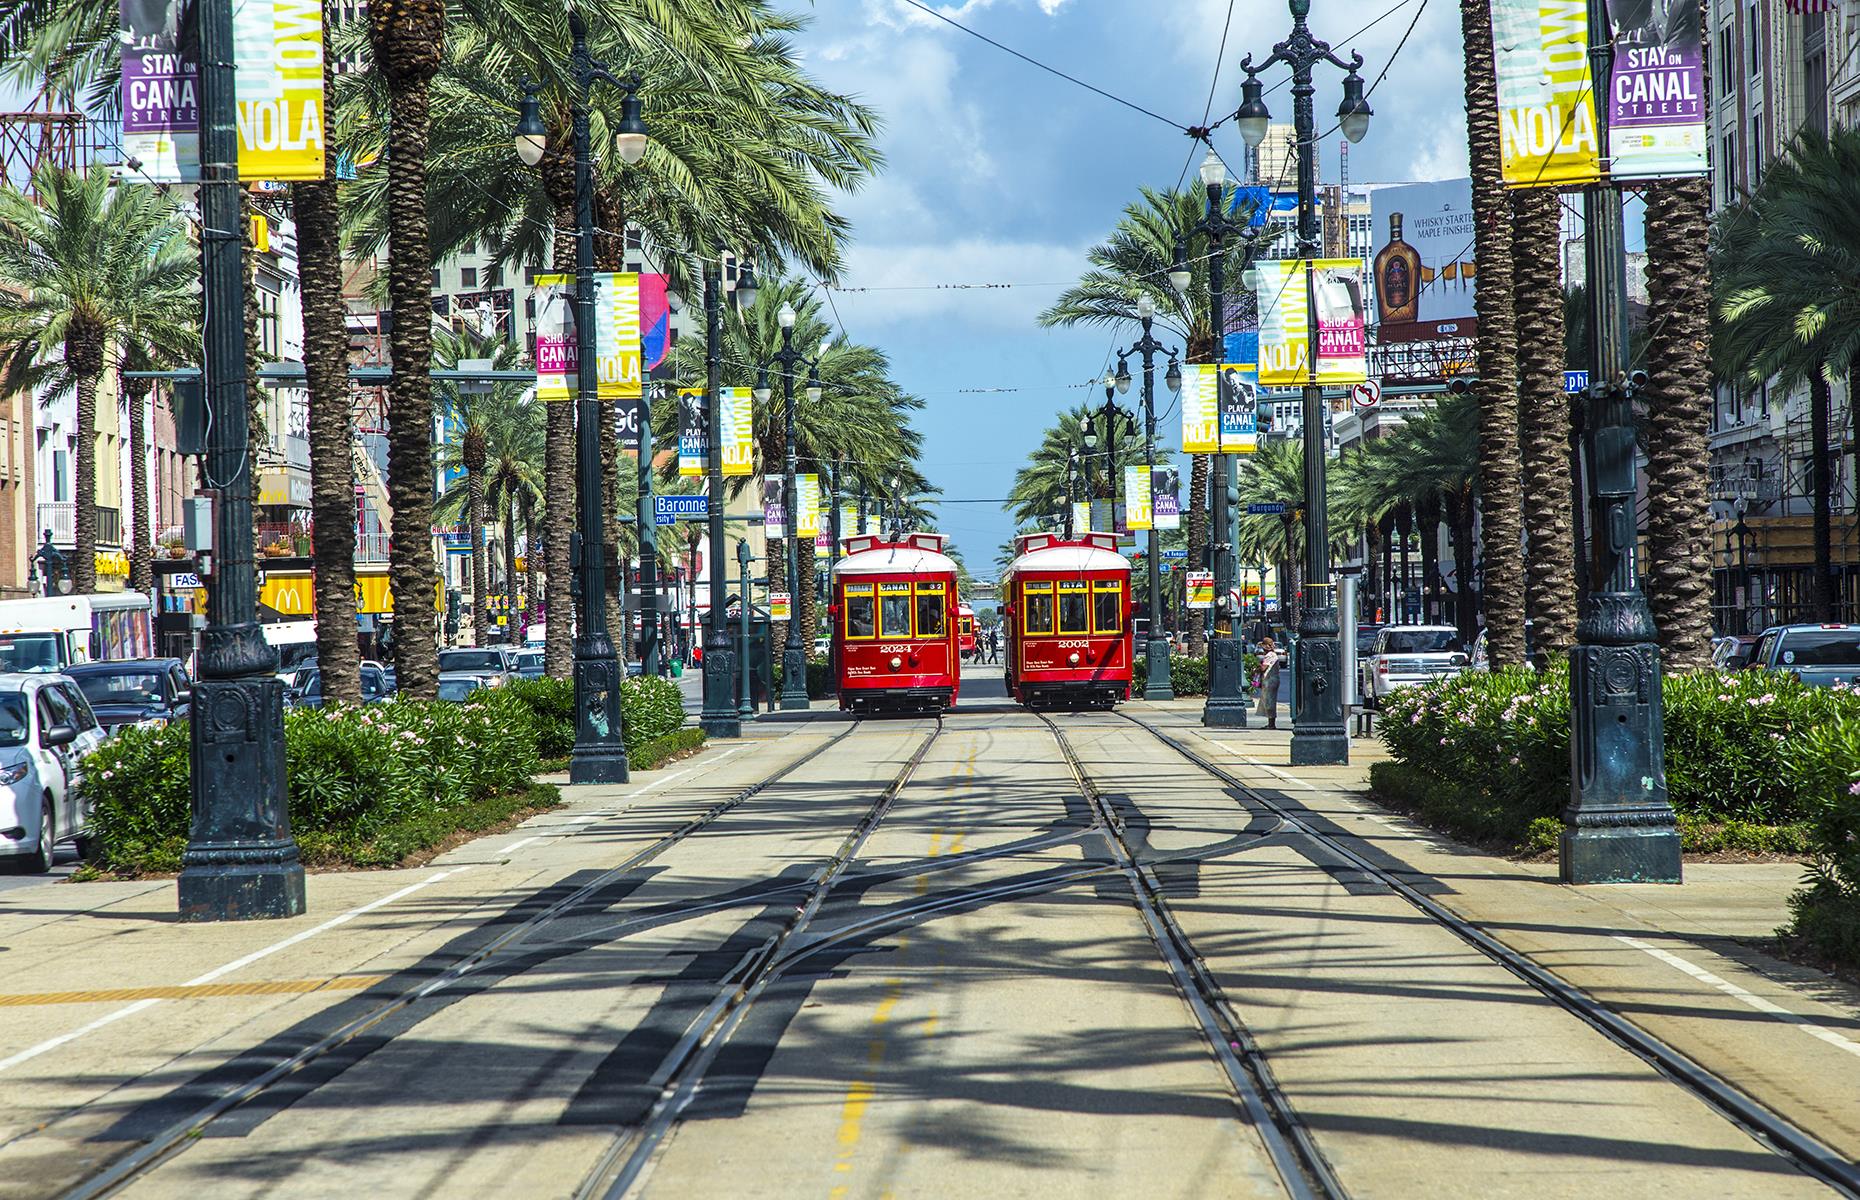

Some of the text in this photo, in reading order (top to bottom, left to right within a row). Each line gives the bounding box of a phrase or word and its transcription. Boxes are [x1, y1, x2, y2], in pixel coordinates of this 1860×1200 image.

[1628, 44, 1682, 69] STAY ON
[142, 54, 196, 75] STAY ON
[1616, 71, 1698, 104] CANAL
[130, 80, 196, 110] CANA
[1617, 101, 1698, 115] STREET
[131, 110, 197, 122] STREE
[237, 100, 324, 151] NOLA
[1503, 102, 1598, 159] NOLA
[1414, 216, 1444, 230] WHISKY
[1418, 228, 1441, 239] MAPLE
[1324, 317, 1346, 328] SHOP
[545, 333, 569, 344] SHOP
[1320, 330, 1360, 345] CANAL
[1320, 345, 1361, 353] STREET
[1260, 344, 1309, 371] NOLA
[1565, 374, 1588, 390] phi
[1224, 415, 1254, 425] CANAL
[1183, 423, 1217, 443] NOLA
[658, 497, 706, 512] Baronne
[1156, 501, 1177, 509] CANAL
[1252, 504, 1283, 513] Burgundy
[1127, 507, 1151, 522] NOLA
[880, 583, 909, 591] CANAL
[880, 644, 912, 653] 2024
[1058, 640, 1089, 648] 2002
